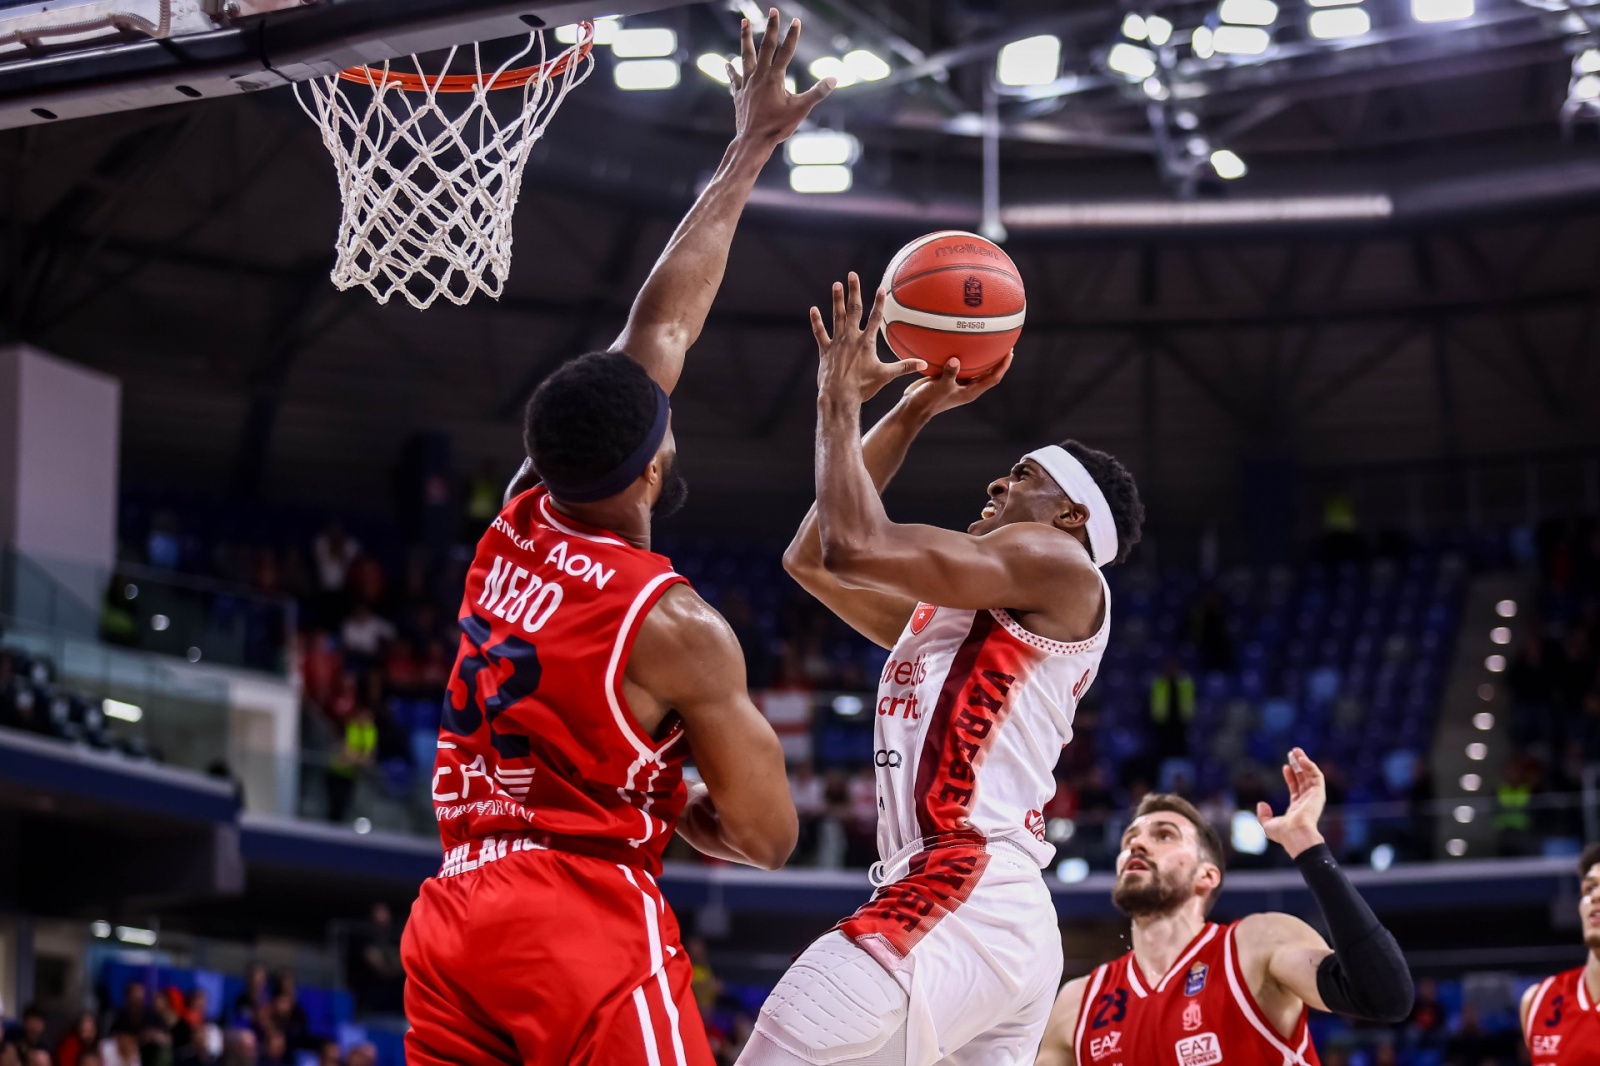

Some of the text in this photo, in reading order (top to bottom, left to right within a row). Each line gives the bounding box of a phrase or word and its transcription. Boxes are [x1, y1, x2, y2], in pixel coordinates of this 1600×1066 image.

[935, 243, 999, 261] molten
[545, 541, 616, 590] AON
[477, 555, 564, 633] NEBO
[1092, 987, 1128, 1030] 23
[1090, 1030, 1121, 1058] EA7
[1179, 1036, 1212, 1057] EA7
